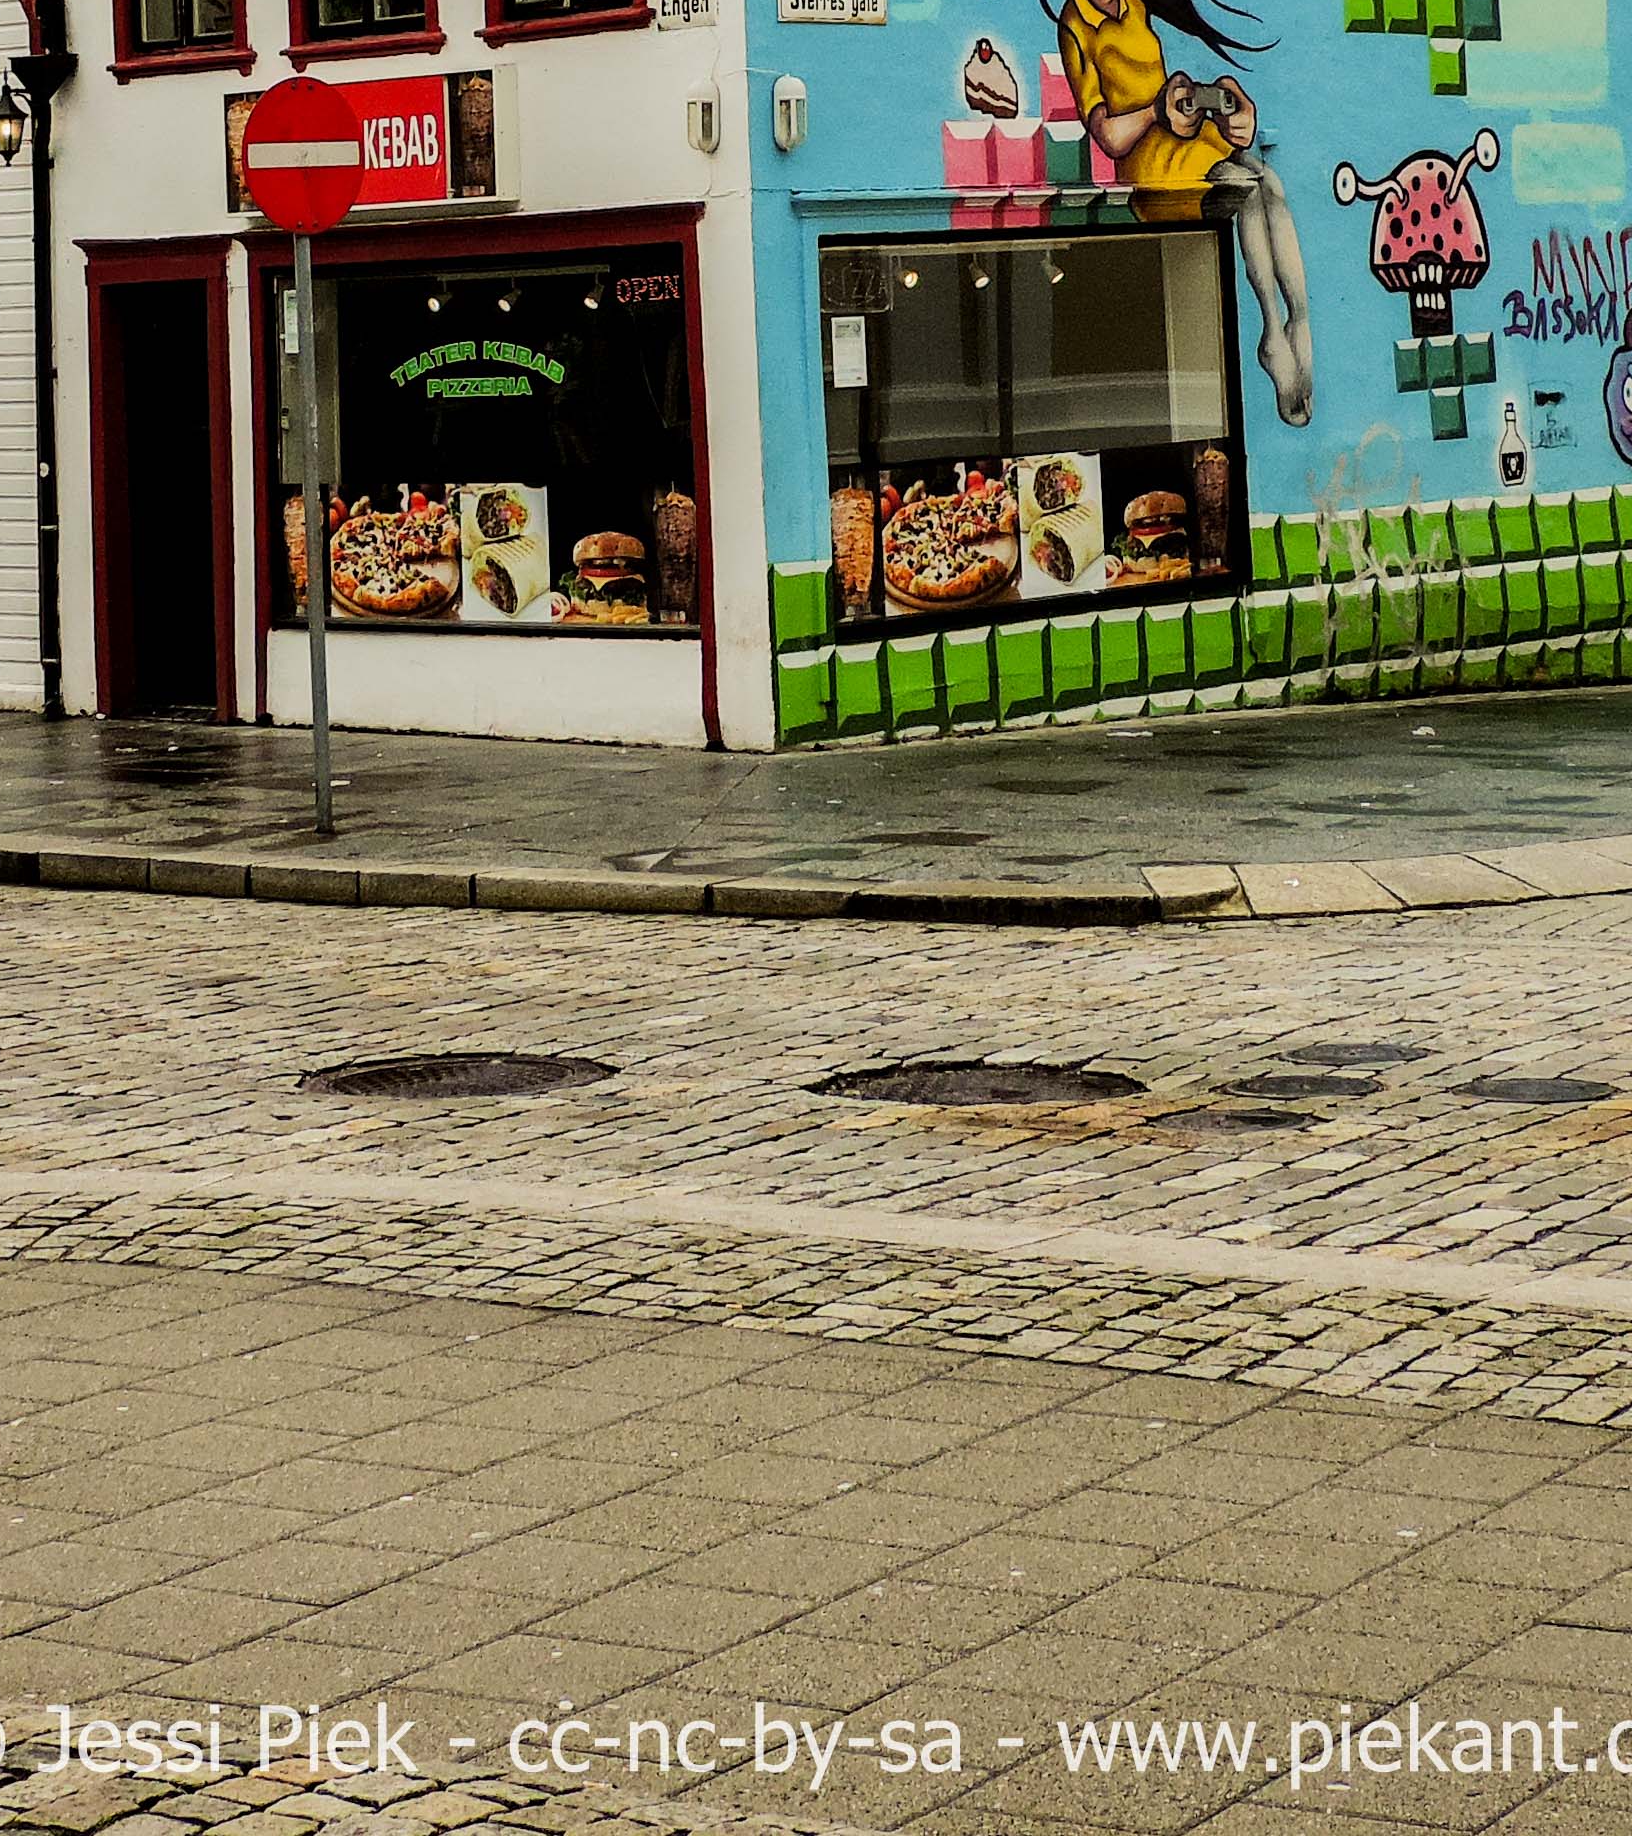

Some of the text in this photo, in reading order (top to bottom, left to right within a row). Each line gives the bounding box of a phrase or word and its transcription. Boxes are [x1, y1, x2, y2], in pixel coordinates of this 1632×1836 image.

[363, 114, 440, 171] KEBAB
[615, 275, 681, 303] OPEN
[390, 340, 566, 387] TEATER KEBAB
[426, 376, 533, 399] PIZZERIA
